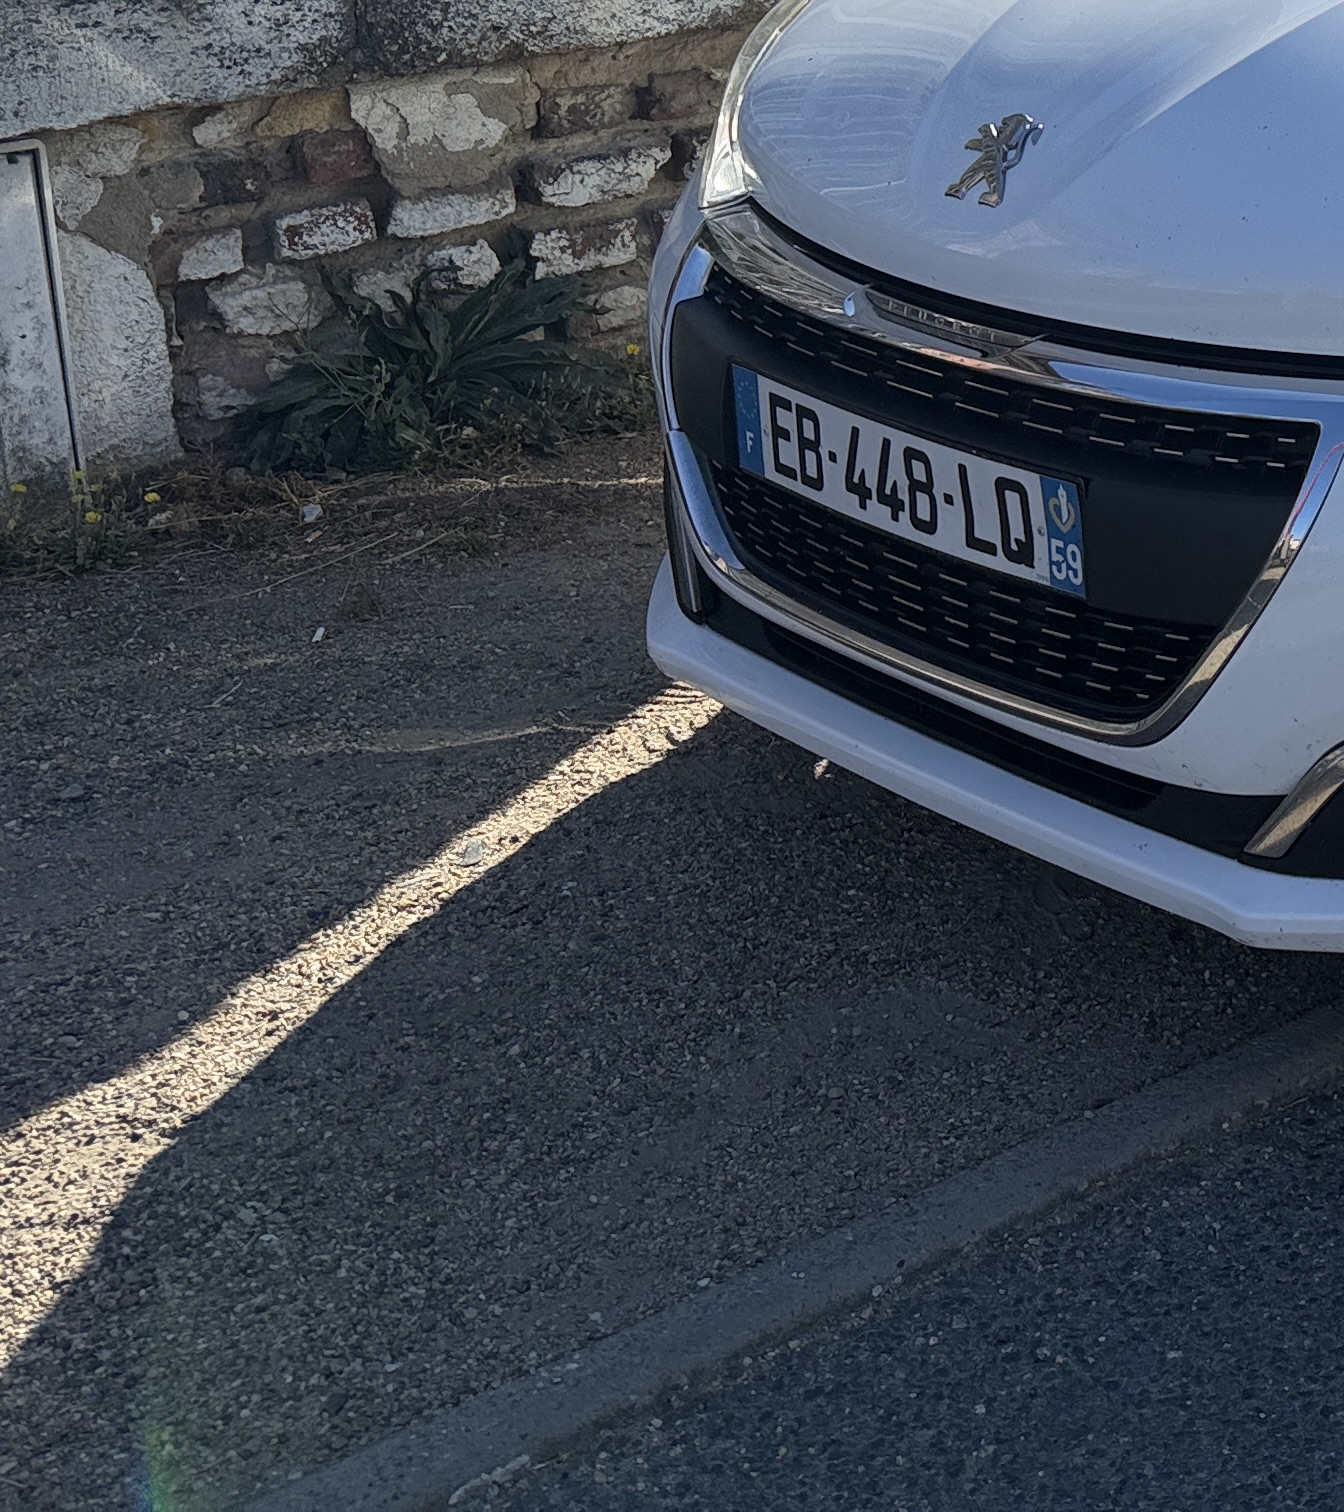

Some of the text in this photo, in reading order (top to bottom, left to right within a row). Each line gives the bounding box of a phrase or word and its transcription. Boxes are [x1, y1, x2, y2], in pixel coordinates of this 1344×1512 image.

[743, 430, 755, 456] F
[768, 390, 1036, 570] EB-448-LQ
[1050, 537, 1084, 586] 59
